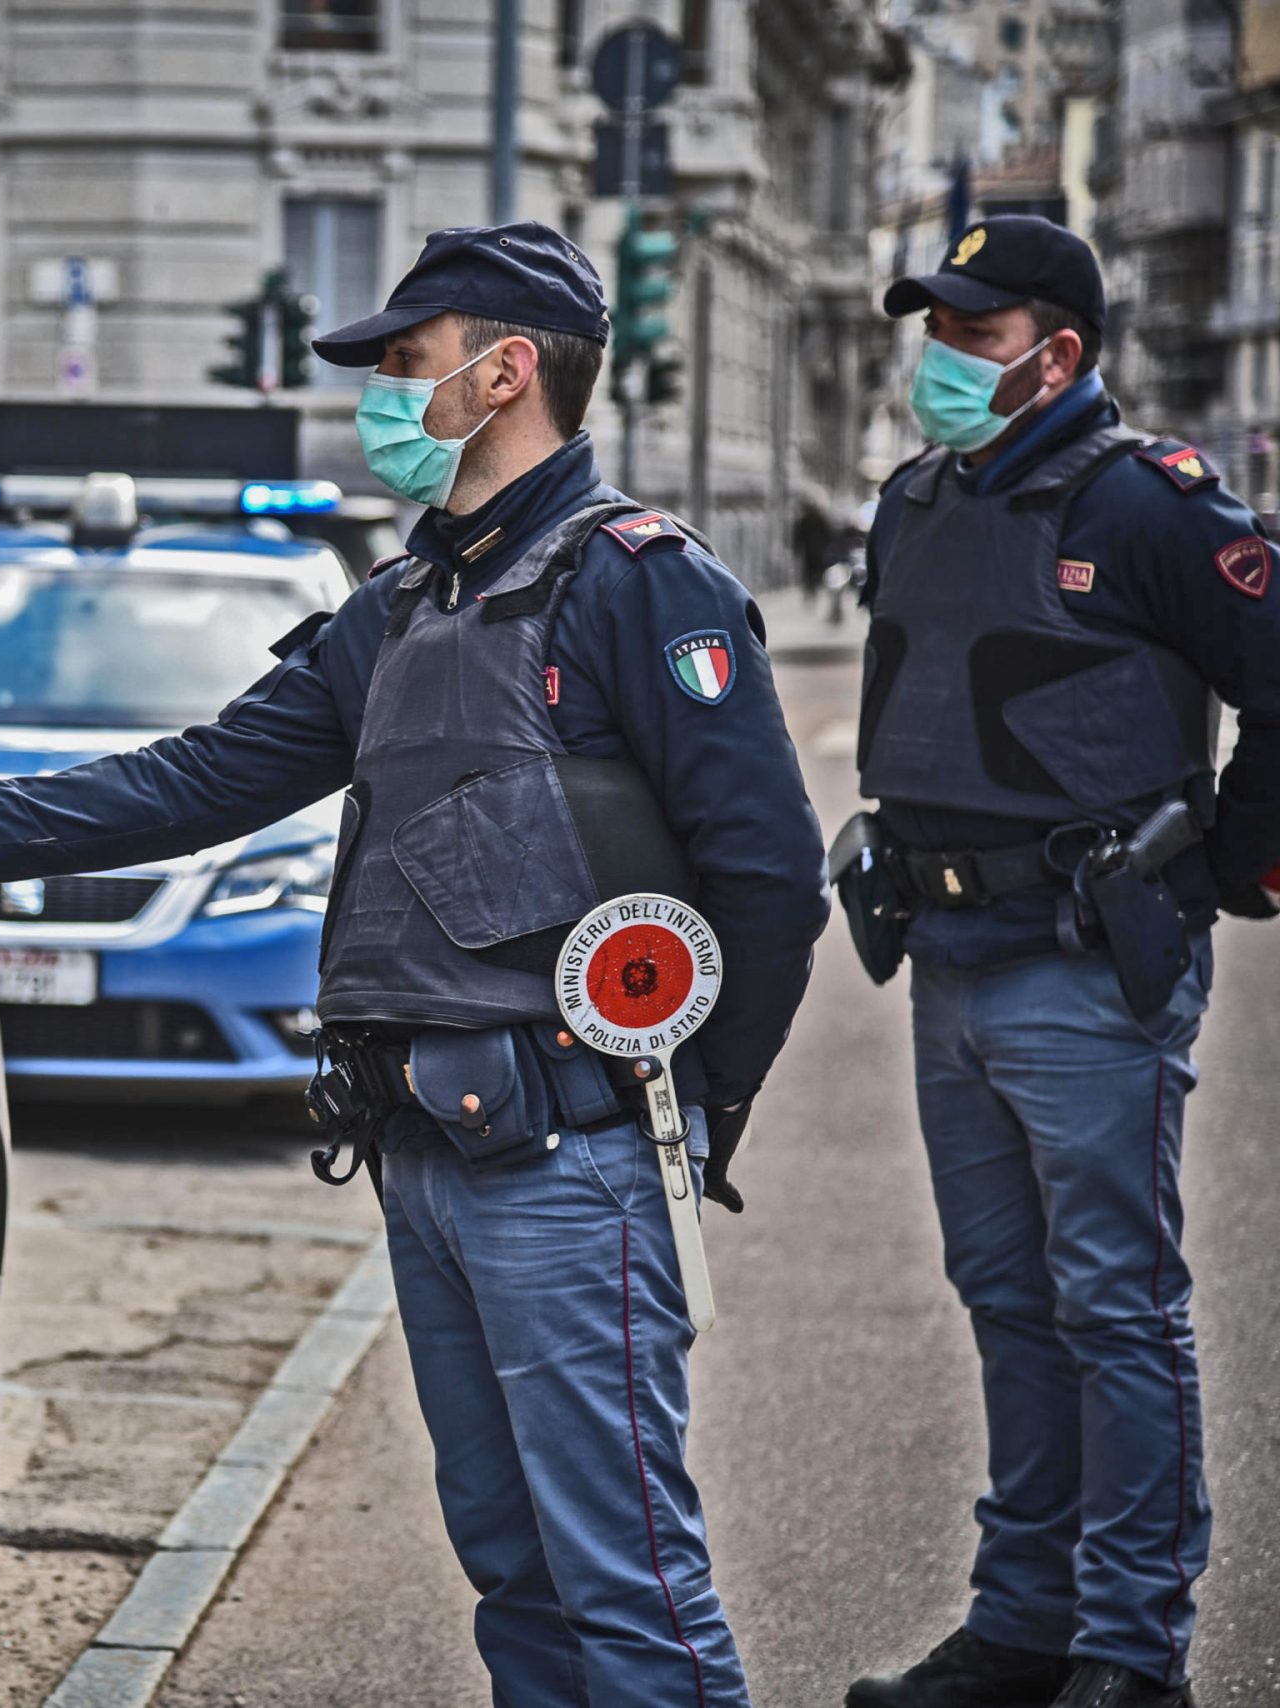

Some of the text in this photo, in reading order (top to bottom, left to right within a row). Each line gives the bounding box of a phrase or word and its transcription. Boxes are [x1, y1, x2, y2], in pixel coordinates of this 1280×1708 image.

[676, 638, 720, 656] ITALIA
[619, 903, 716, 976] DELL'INTERNO
[583, 995, 709, 1052] POLIZIA DI STATO
